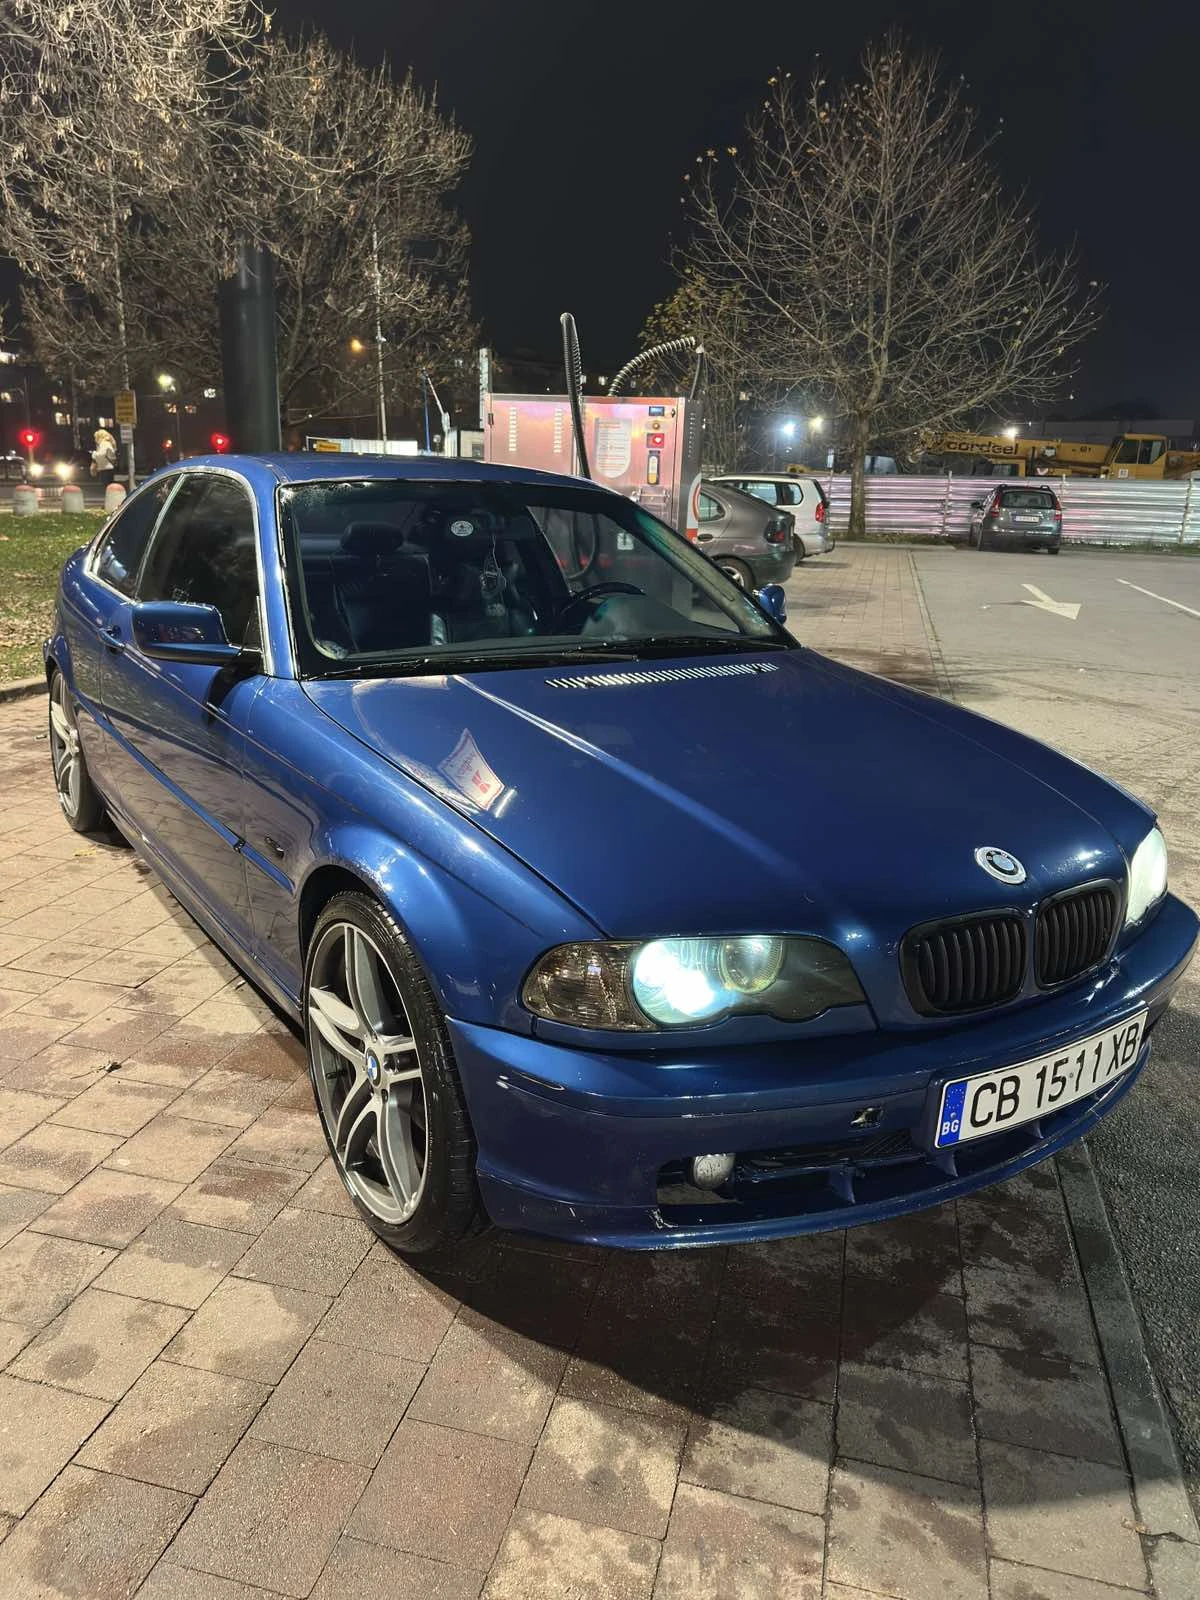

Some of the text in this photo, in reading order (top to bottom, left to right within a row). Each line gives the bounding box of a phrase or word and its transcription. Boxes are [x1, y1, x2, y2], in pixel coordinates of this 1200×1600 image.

[970, 1022, 1140, 1128] CB 1511 XB
[941, 1120, 959, 1136] BG
